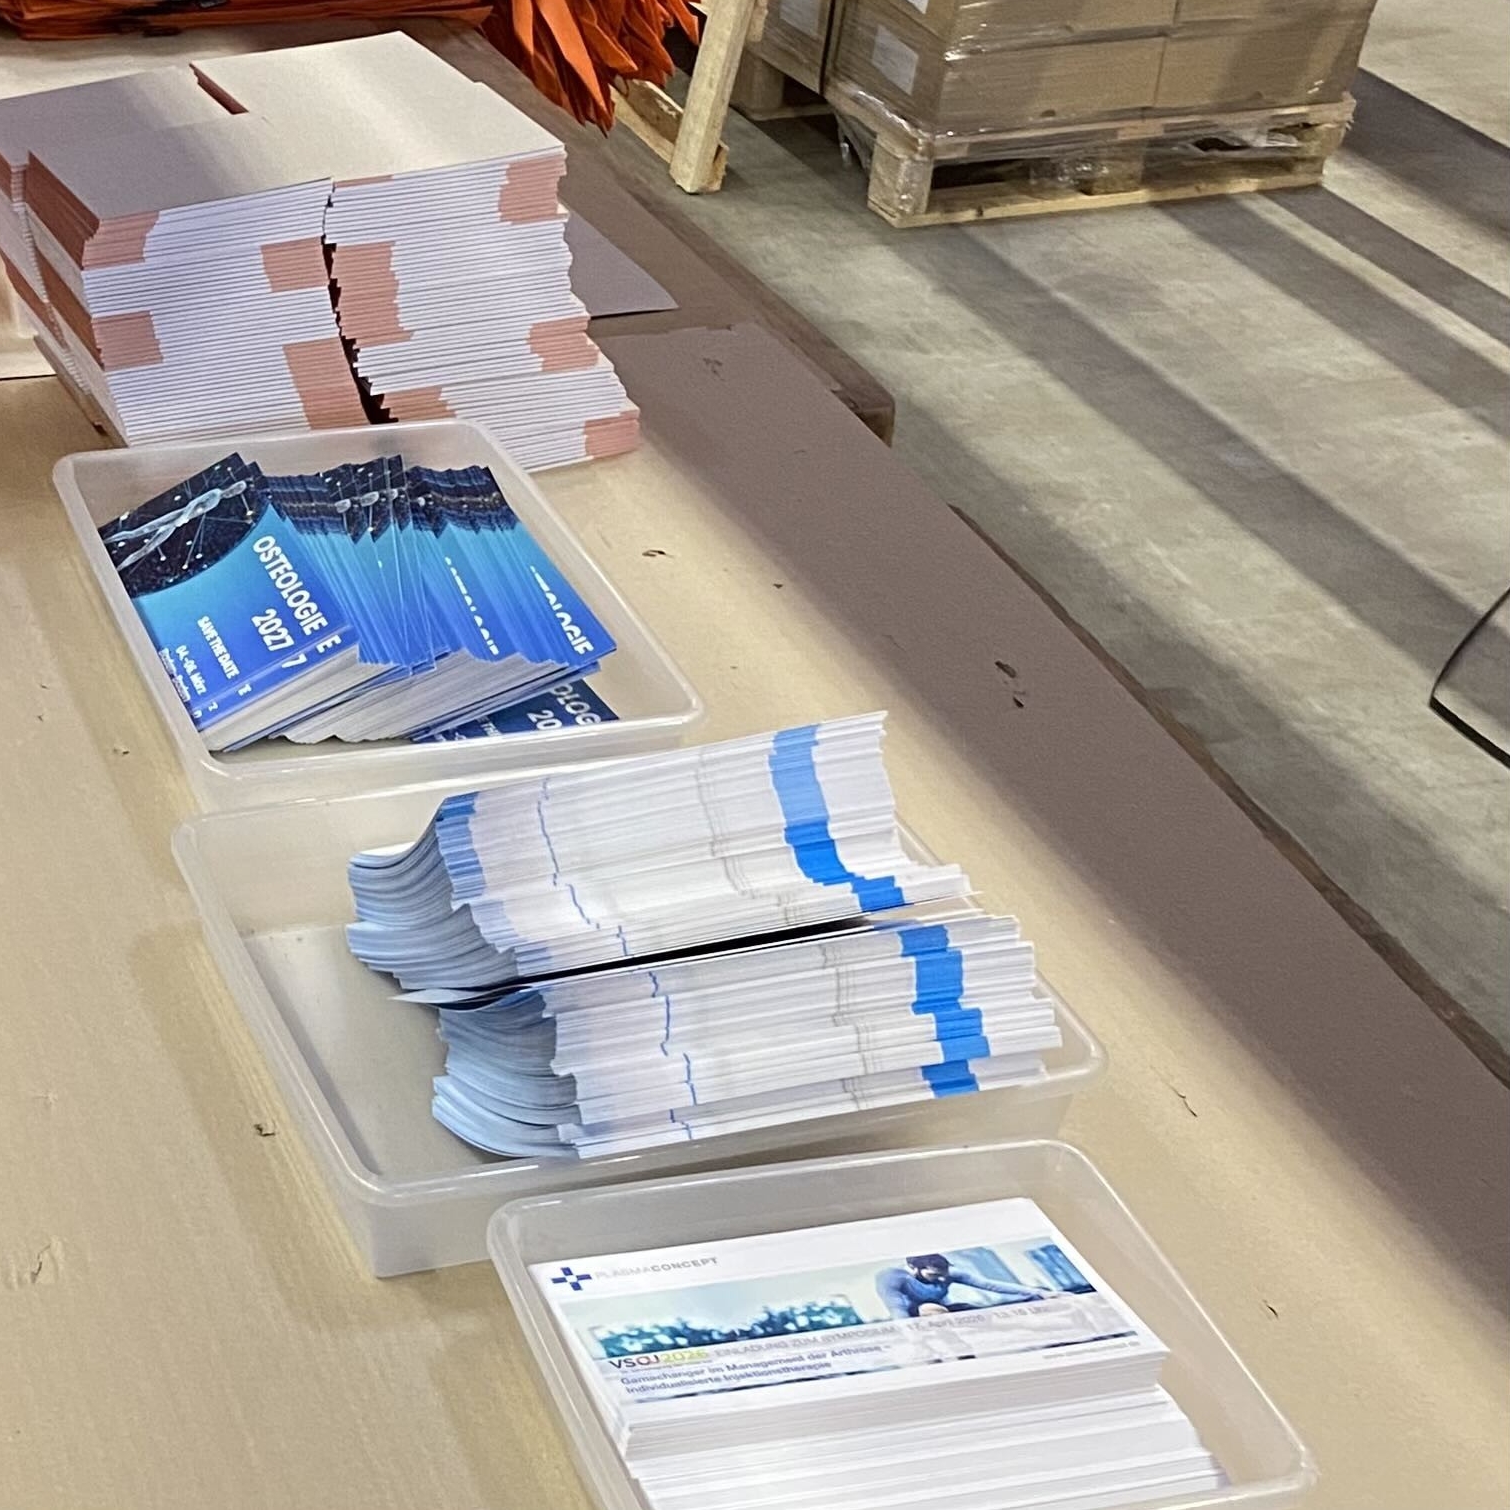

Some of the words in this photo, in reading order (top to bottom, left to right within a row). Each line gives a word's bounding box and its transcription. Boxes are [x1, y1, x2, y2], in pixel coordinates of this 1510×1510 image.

[253, 536, 328, 636] OSTEOLOGIE
[251, 608, 294, 651] 2027
[197, 615, 219, 641] SAVE
[209, 637, 229, 658] THE
[219, 653, 240, 679] DATE
[595, 1256, 718, 1280] PLASMACONCEPT
[714, 1341, 789, 1358] EINLADUNG
[791, 1336, 819, 1349] ZUM
[821, 1325, 897, 1343] SYMPOSIUM
[725, 1354, 805, 1372] Management
[806, 1351, 827, 1361] der
[830, 1346, 882, 1358] Arthrose
[626, 1375, 722, 1395] Individualisierte
[723, 1362, 832, 1382] Injektionstherapie
